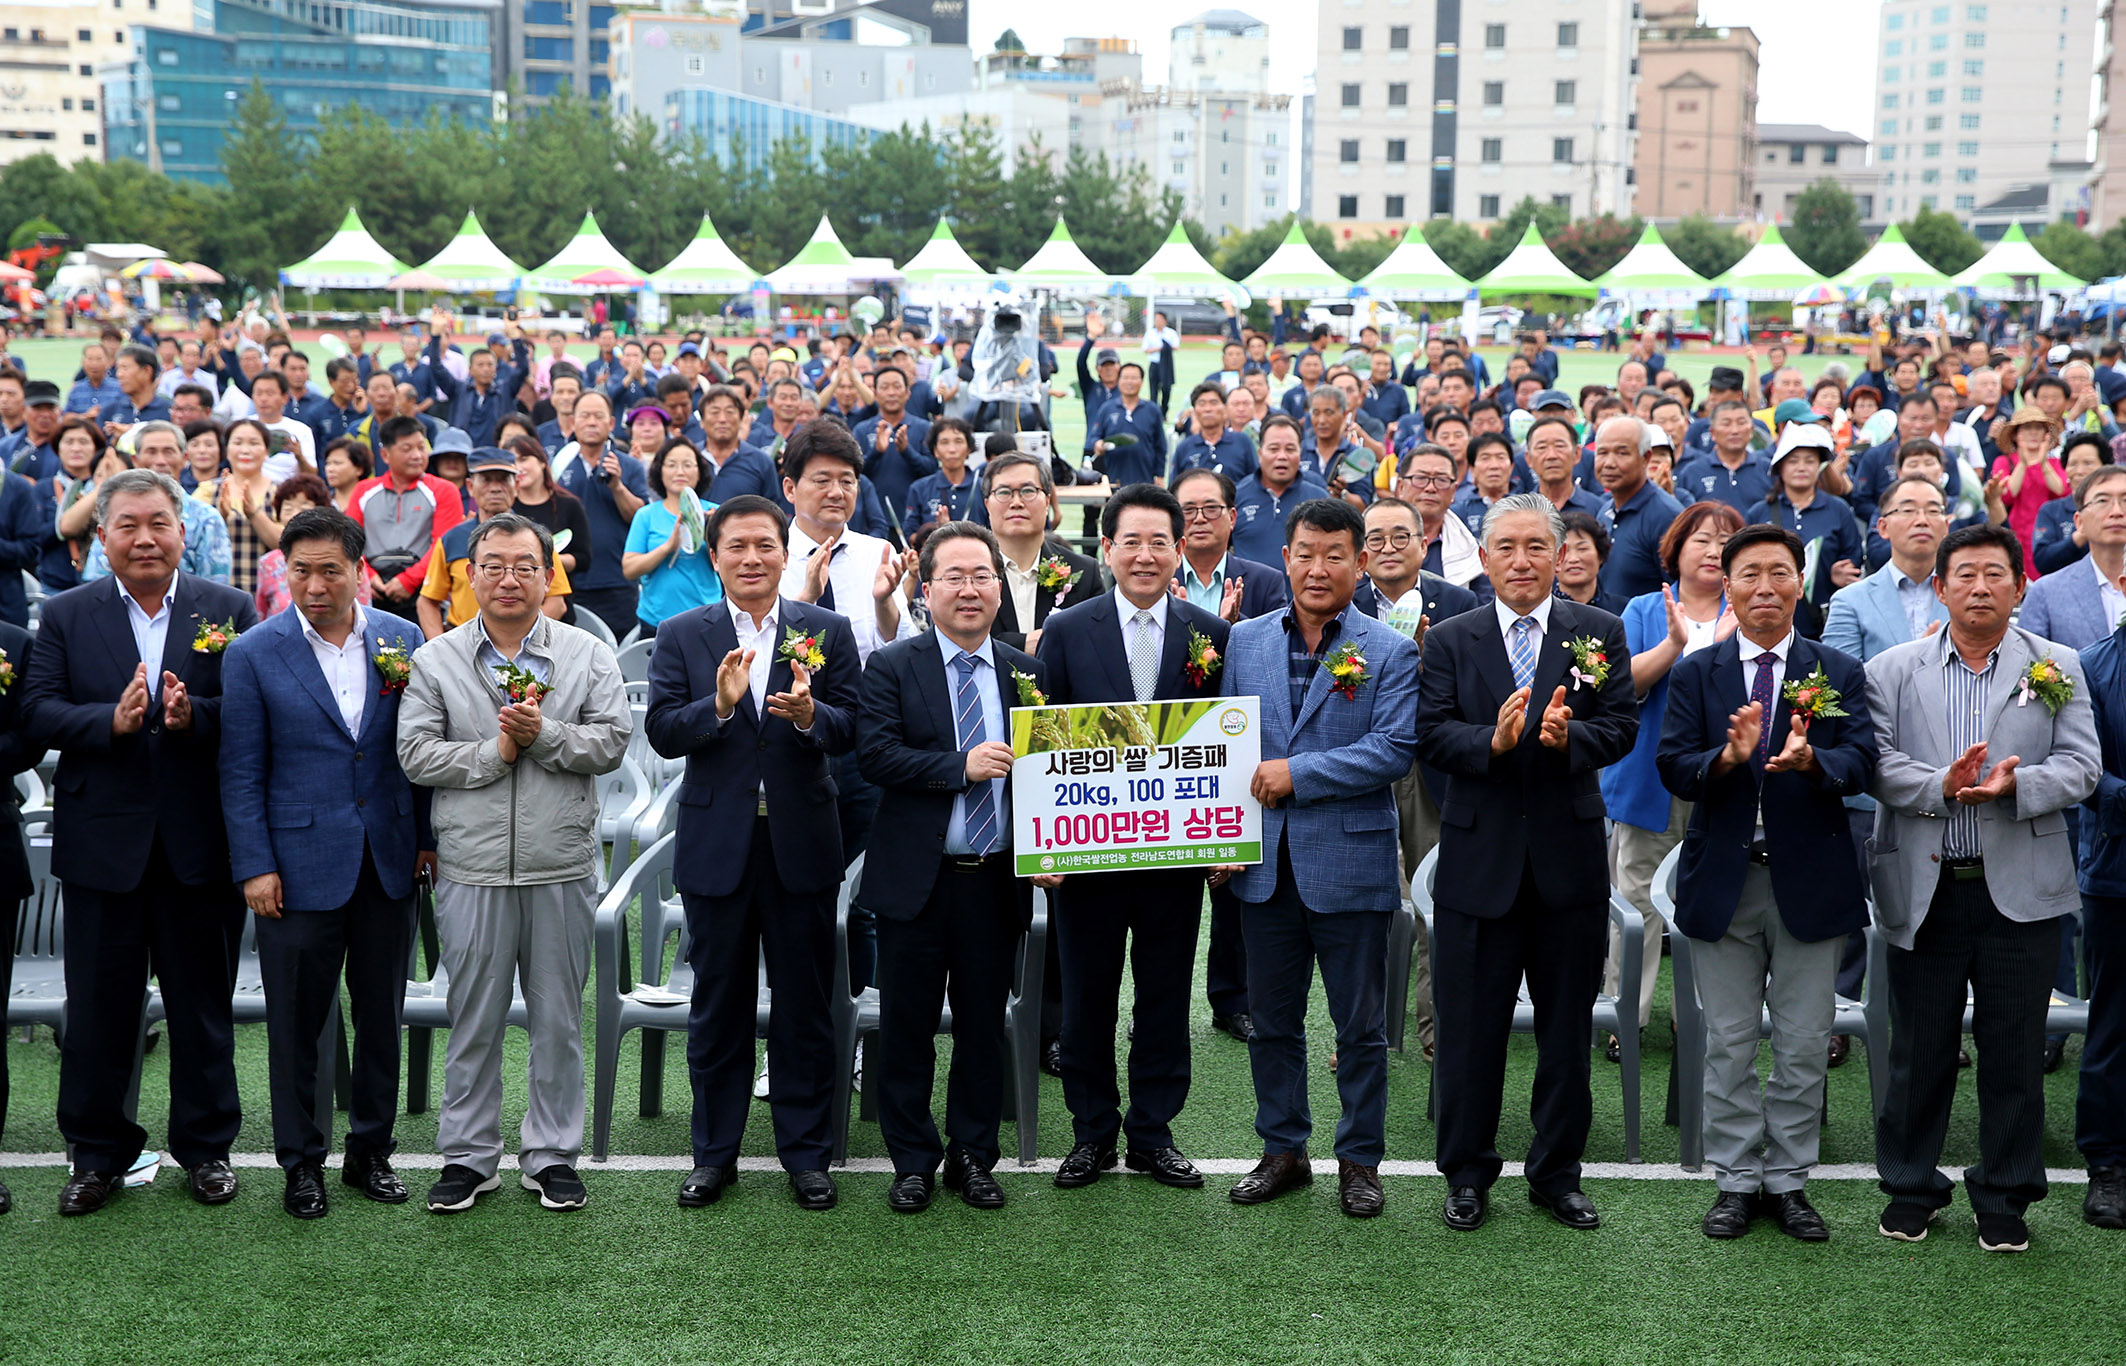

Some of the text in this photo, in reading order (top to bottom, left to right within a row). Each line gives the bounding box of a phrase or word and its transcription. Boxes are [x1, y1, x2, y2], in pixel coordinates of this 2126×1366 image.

[1045, 744, 1227, 776] 사랑의 쌀 기증패
[1054, 775, 1220, 807] 20kg, 100 포대
[1032, 806, 1245, 850] 1,000만원 상당
[1056, 846, 1237, 868] (사)한국쌀전업농 전라남도연합회 회원 일동
